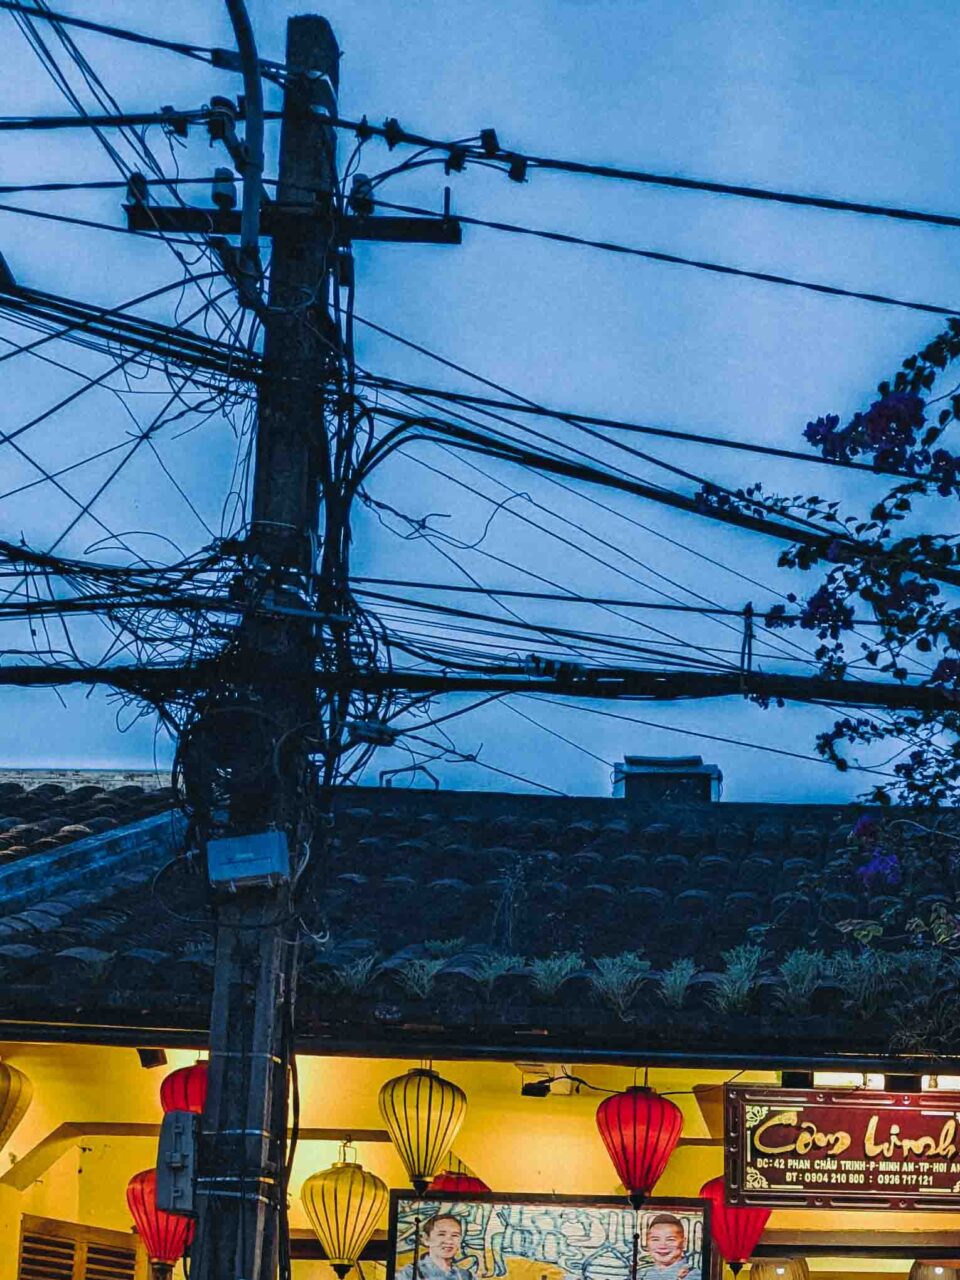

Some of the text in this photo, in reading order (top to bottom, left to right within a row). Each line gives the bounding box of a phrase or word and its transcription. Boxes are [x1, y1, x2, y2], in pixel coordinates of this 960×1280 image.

[865, 1115, 956, 1158] Linh
[787, 1159, 810, 1169] PHAN
[804, 1172, 828, 1183] 0904
[831, 1173, 847, 1183] 210
